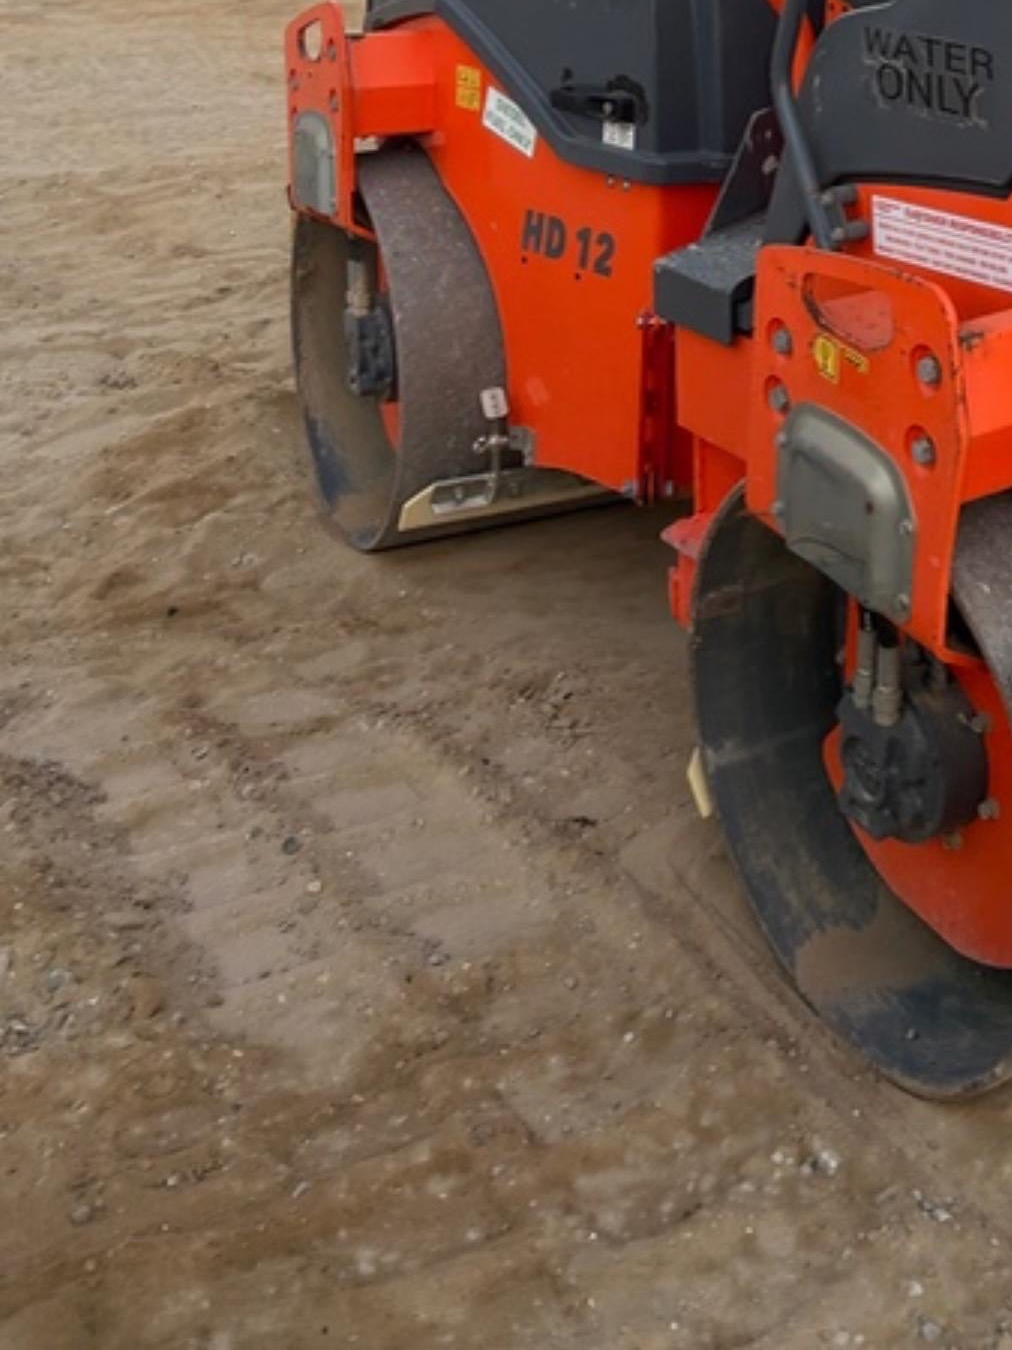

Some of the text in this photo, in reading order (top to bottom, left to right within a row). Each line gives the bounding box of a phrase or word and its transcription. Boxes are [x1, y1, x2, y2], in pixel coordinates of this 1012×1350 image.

[864, 25, 994, 81] WATER
[876, 63, 979, 118] ONLY
[521, 209, 615, 277] HD 12
